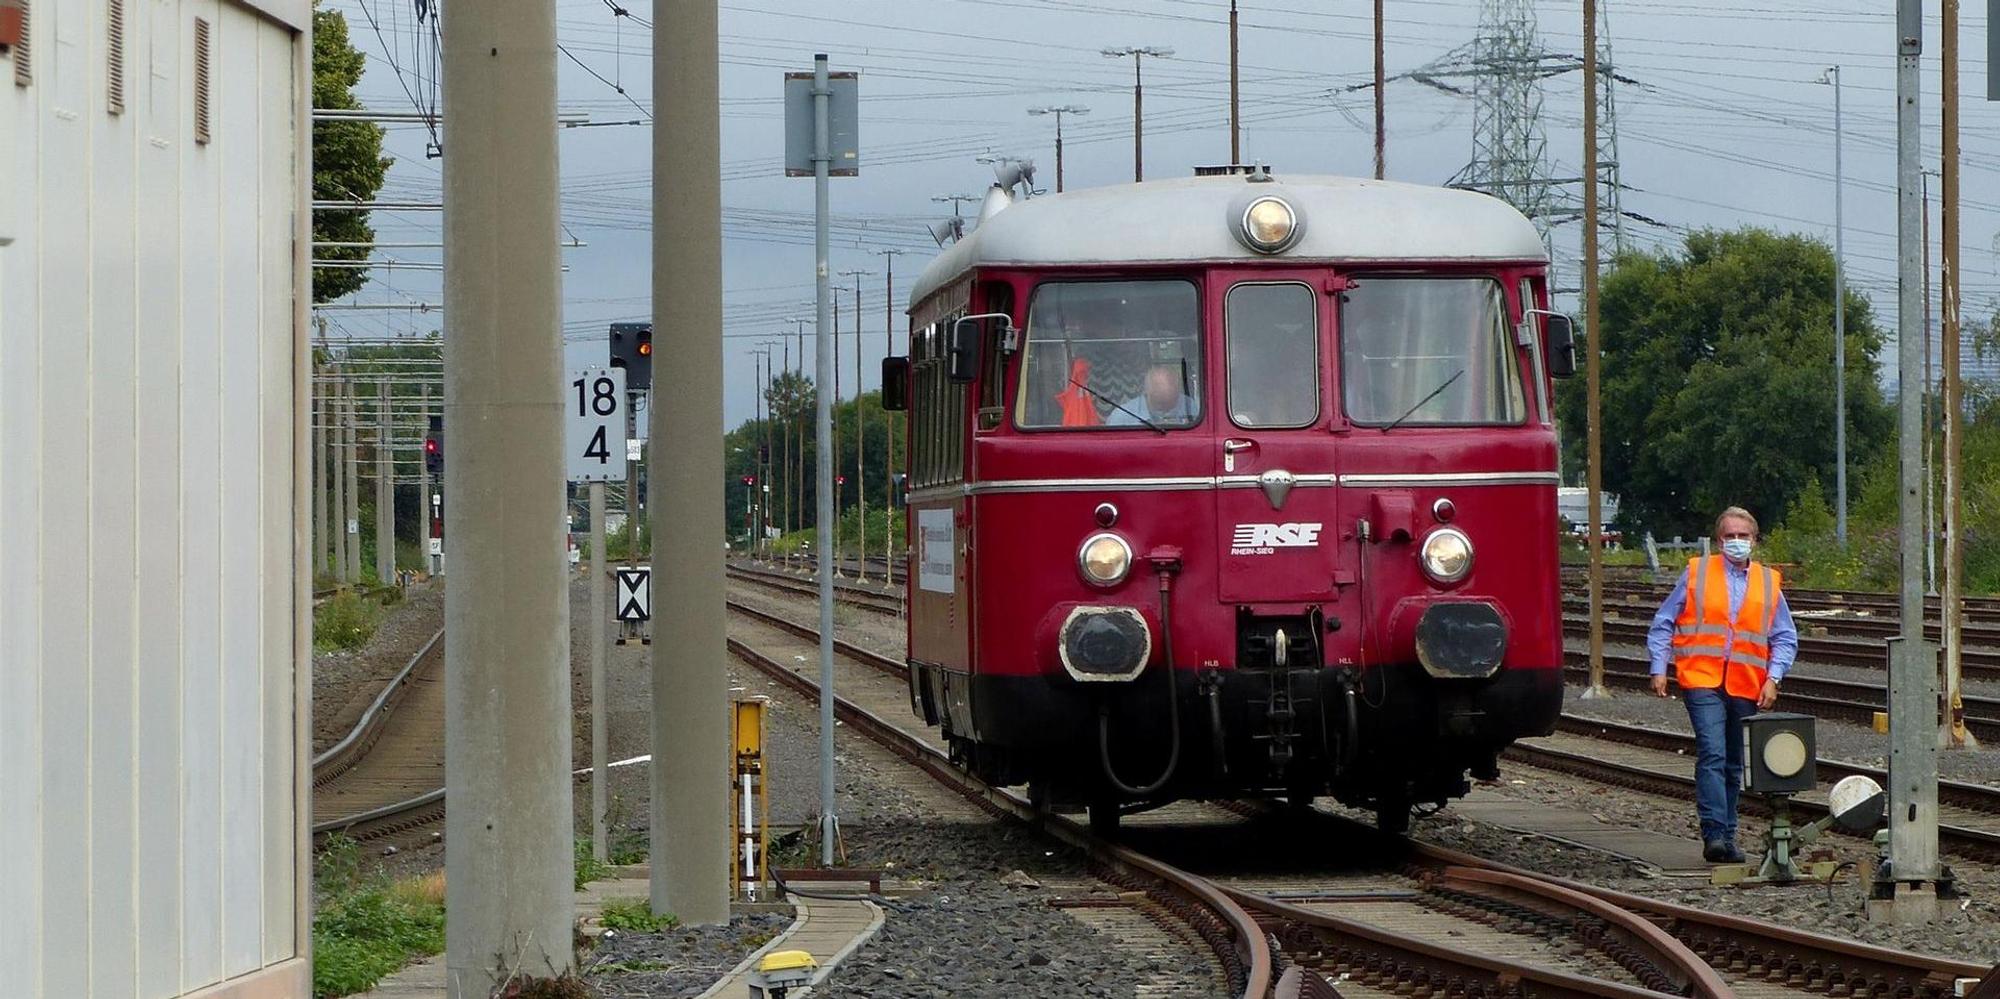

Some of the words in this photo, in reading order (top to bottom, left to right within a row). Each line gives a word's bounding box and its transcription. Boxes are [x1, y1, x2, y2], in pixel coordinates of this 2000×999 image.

[573, 377, 617, 417] 18
[583, 425, 611, 464] 4
[1245, 523, 1323, 546] RSE
[1231, 547, 1274, 555] RHEIN-SIEG
